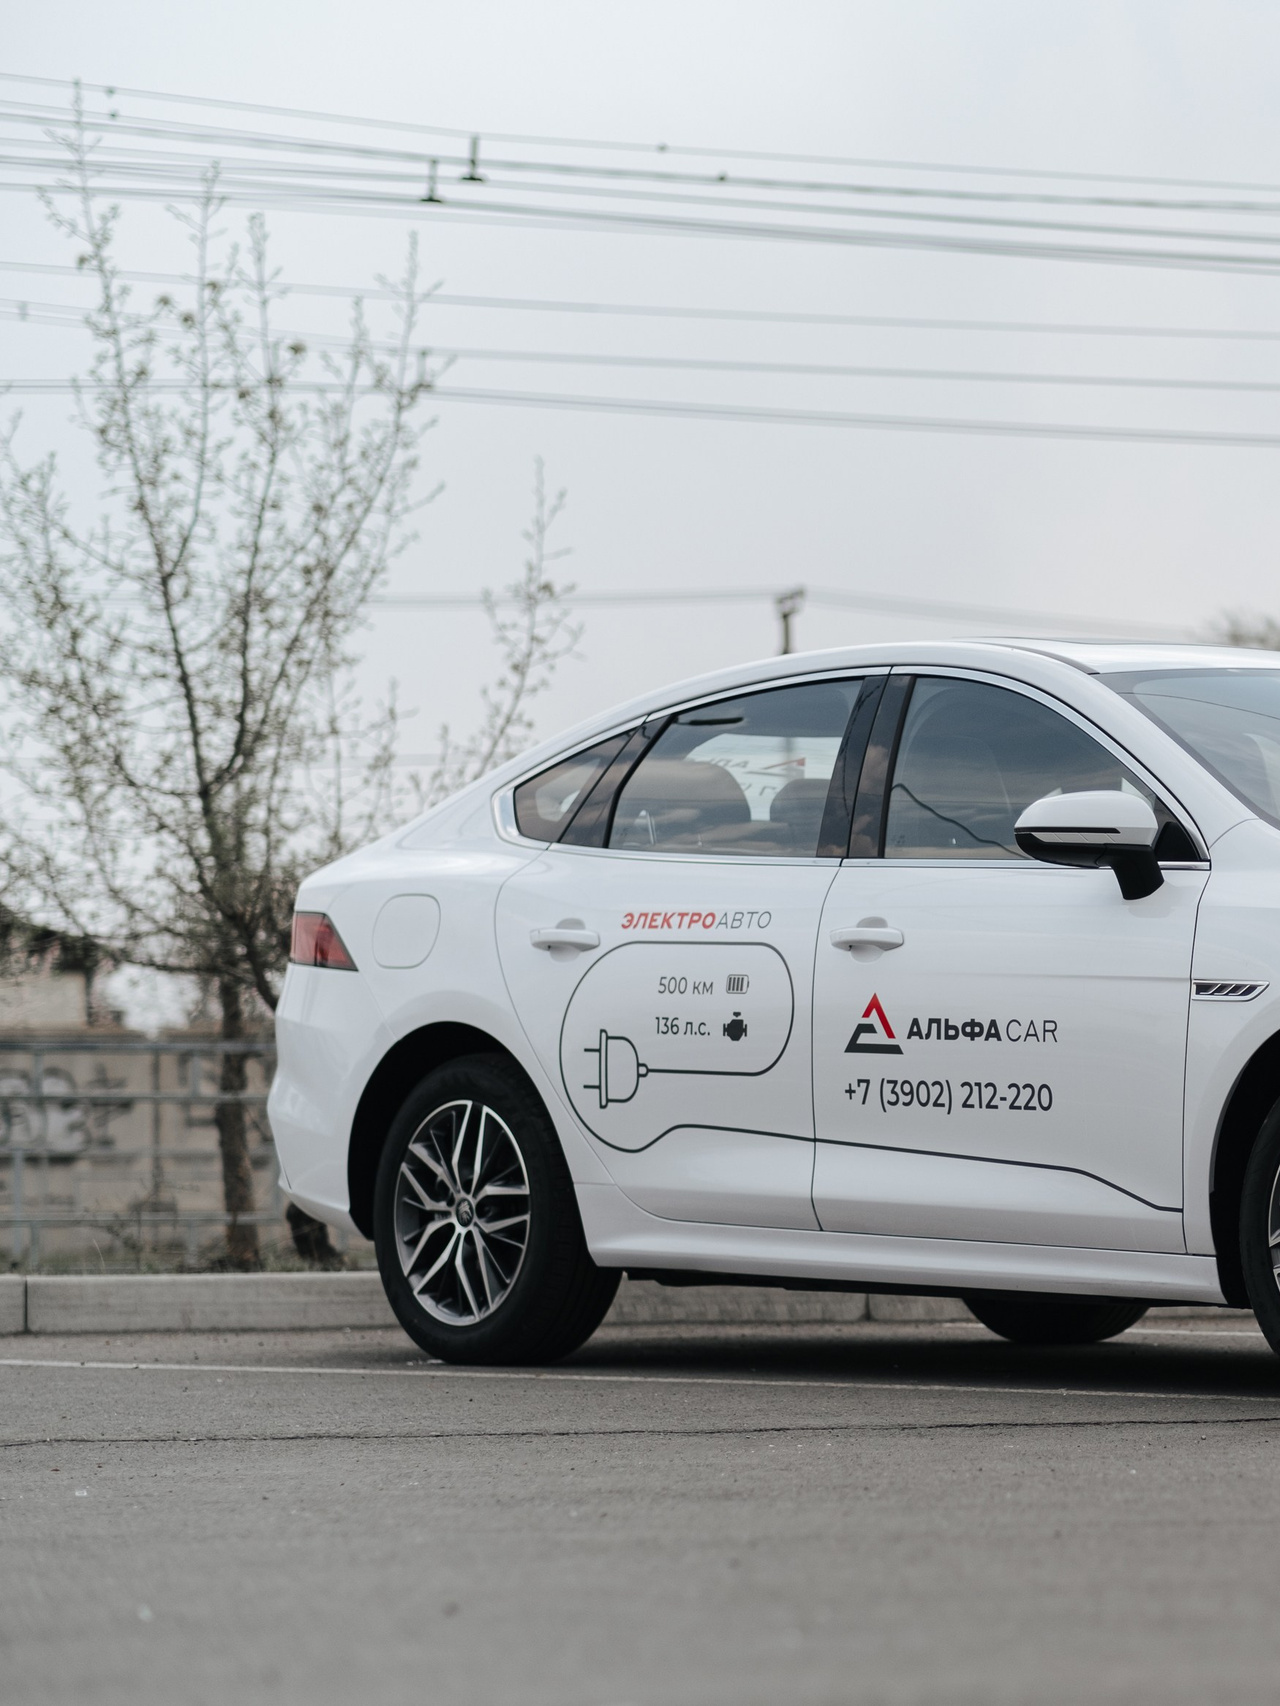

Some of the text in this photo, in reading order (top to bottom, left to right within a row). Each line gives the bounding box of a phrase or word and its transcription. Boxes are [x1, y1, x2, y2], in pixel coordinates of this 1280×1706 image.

[621, 911, 772, 929] ЭЛЕКТРОАВТО
[658, 976, 688, 994] 500
[655, 1017, 679, 1035] 136
[844, 1077, 1053, 1115] +7 (3902) 212-220
